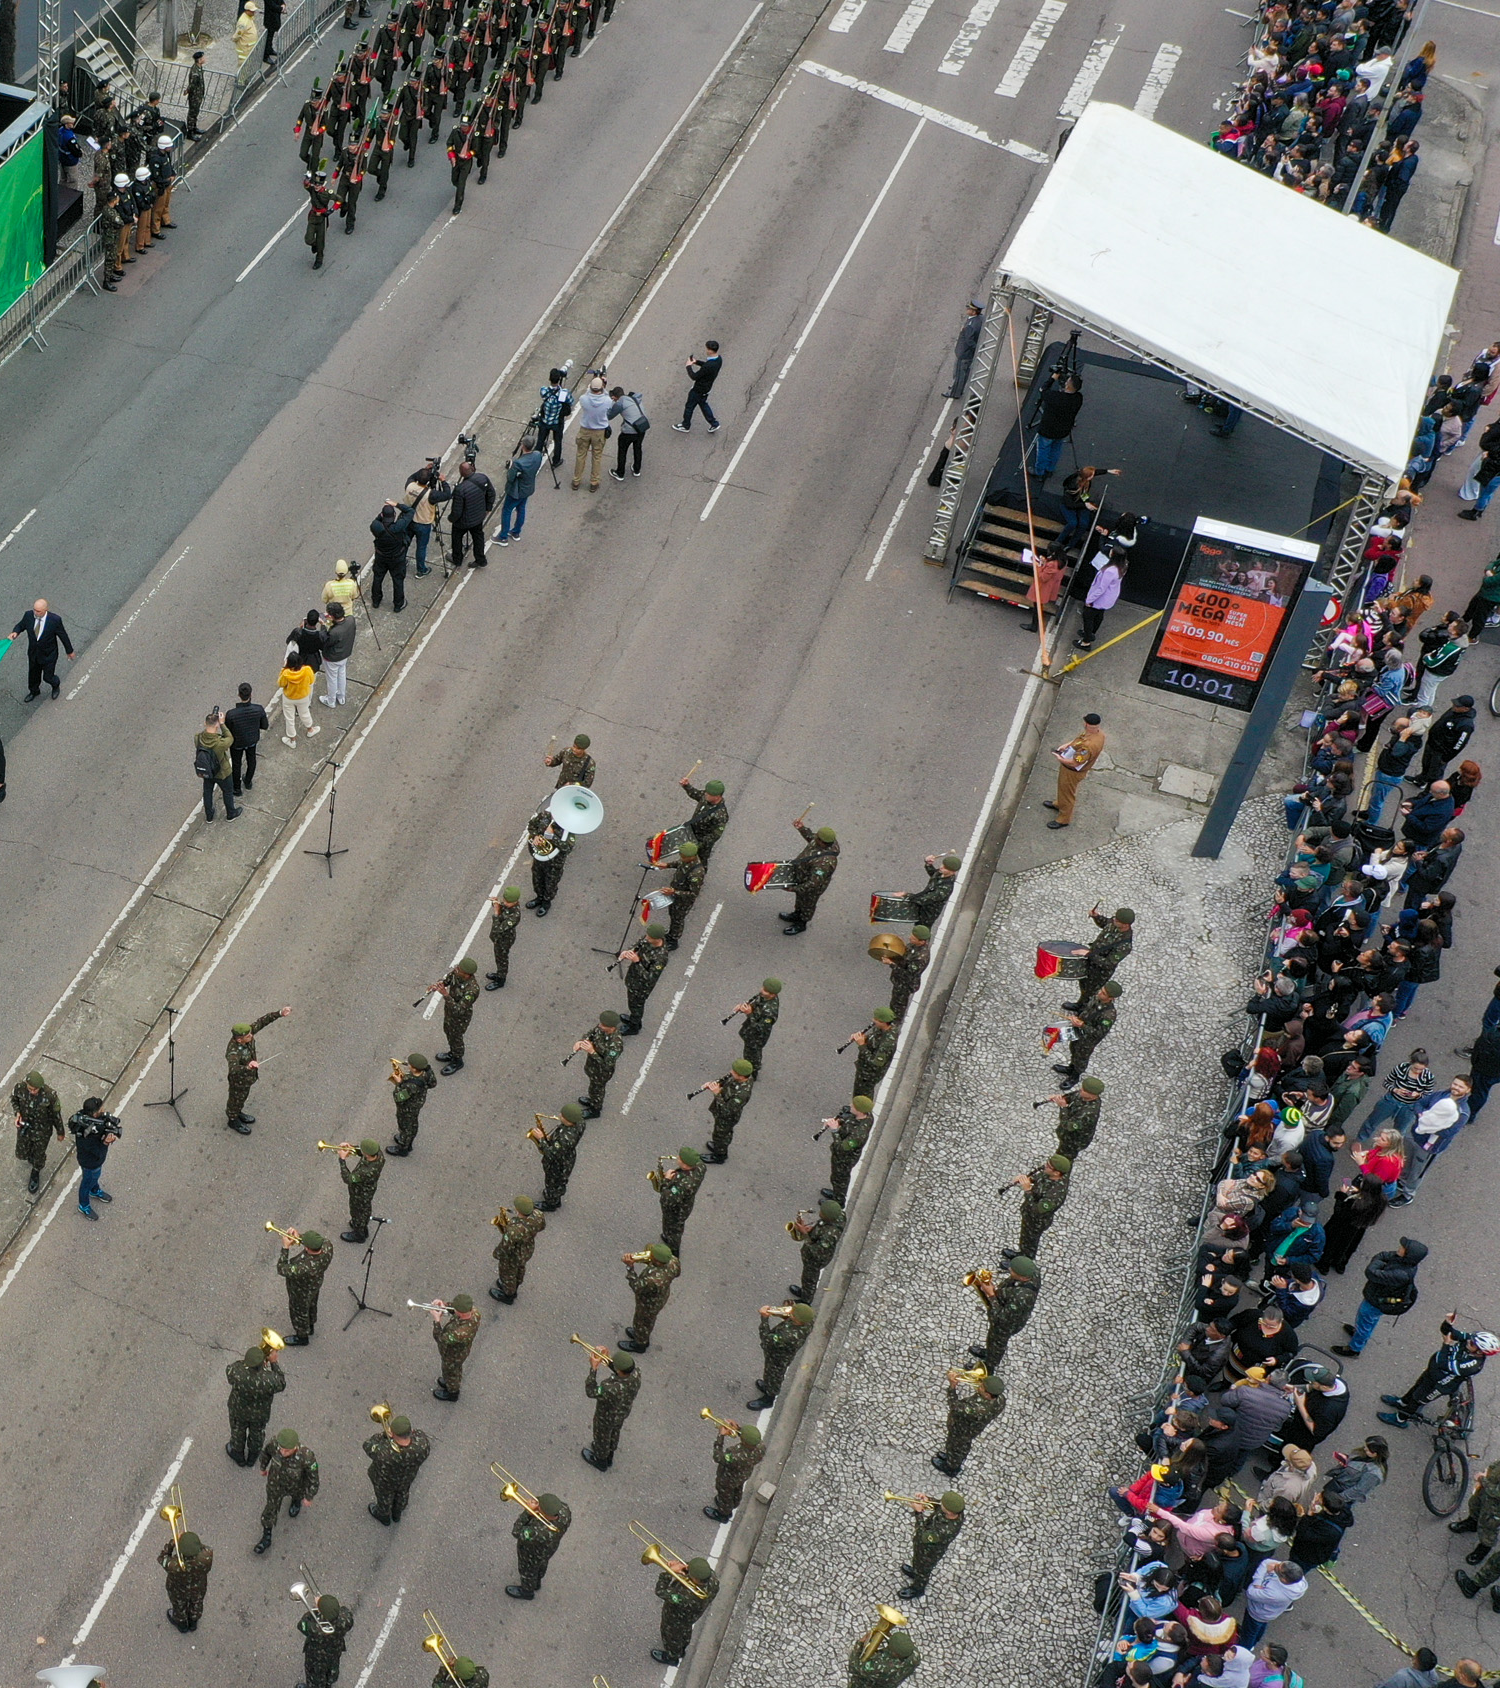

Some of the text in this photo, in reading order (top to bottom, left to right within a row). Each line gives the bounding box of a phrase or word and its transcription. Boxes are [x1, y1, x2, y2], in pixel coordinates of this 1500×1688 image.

[1194, 592, 1230, 609] 400
[1177, 601, 1226, 622] MEGA
[1228, 610, 1248, 618] SUPER
[1225, 618, 1245, 628] MESH
[1182, 625, 1224, 642] 109,90
[1224, 637, 1240, 647] MÊS
[1201, 654, 1223, 665] 0800
[1224, 660, 1239, 669] 410
[1164, 669, 1234, 700] 10:01
